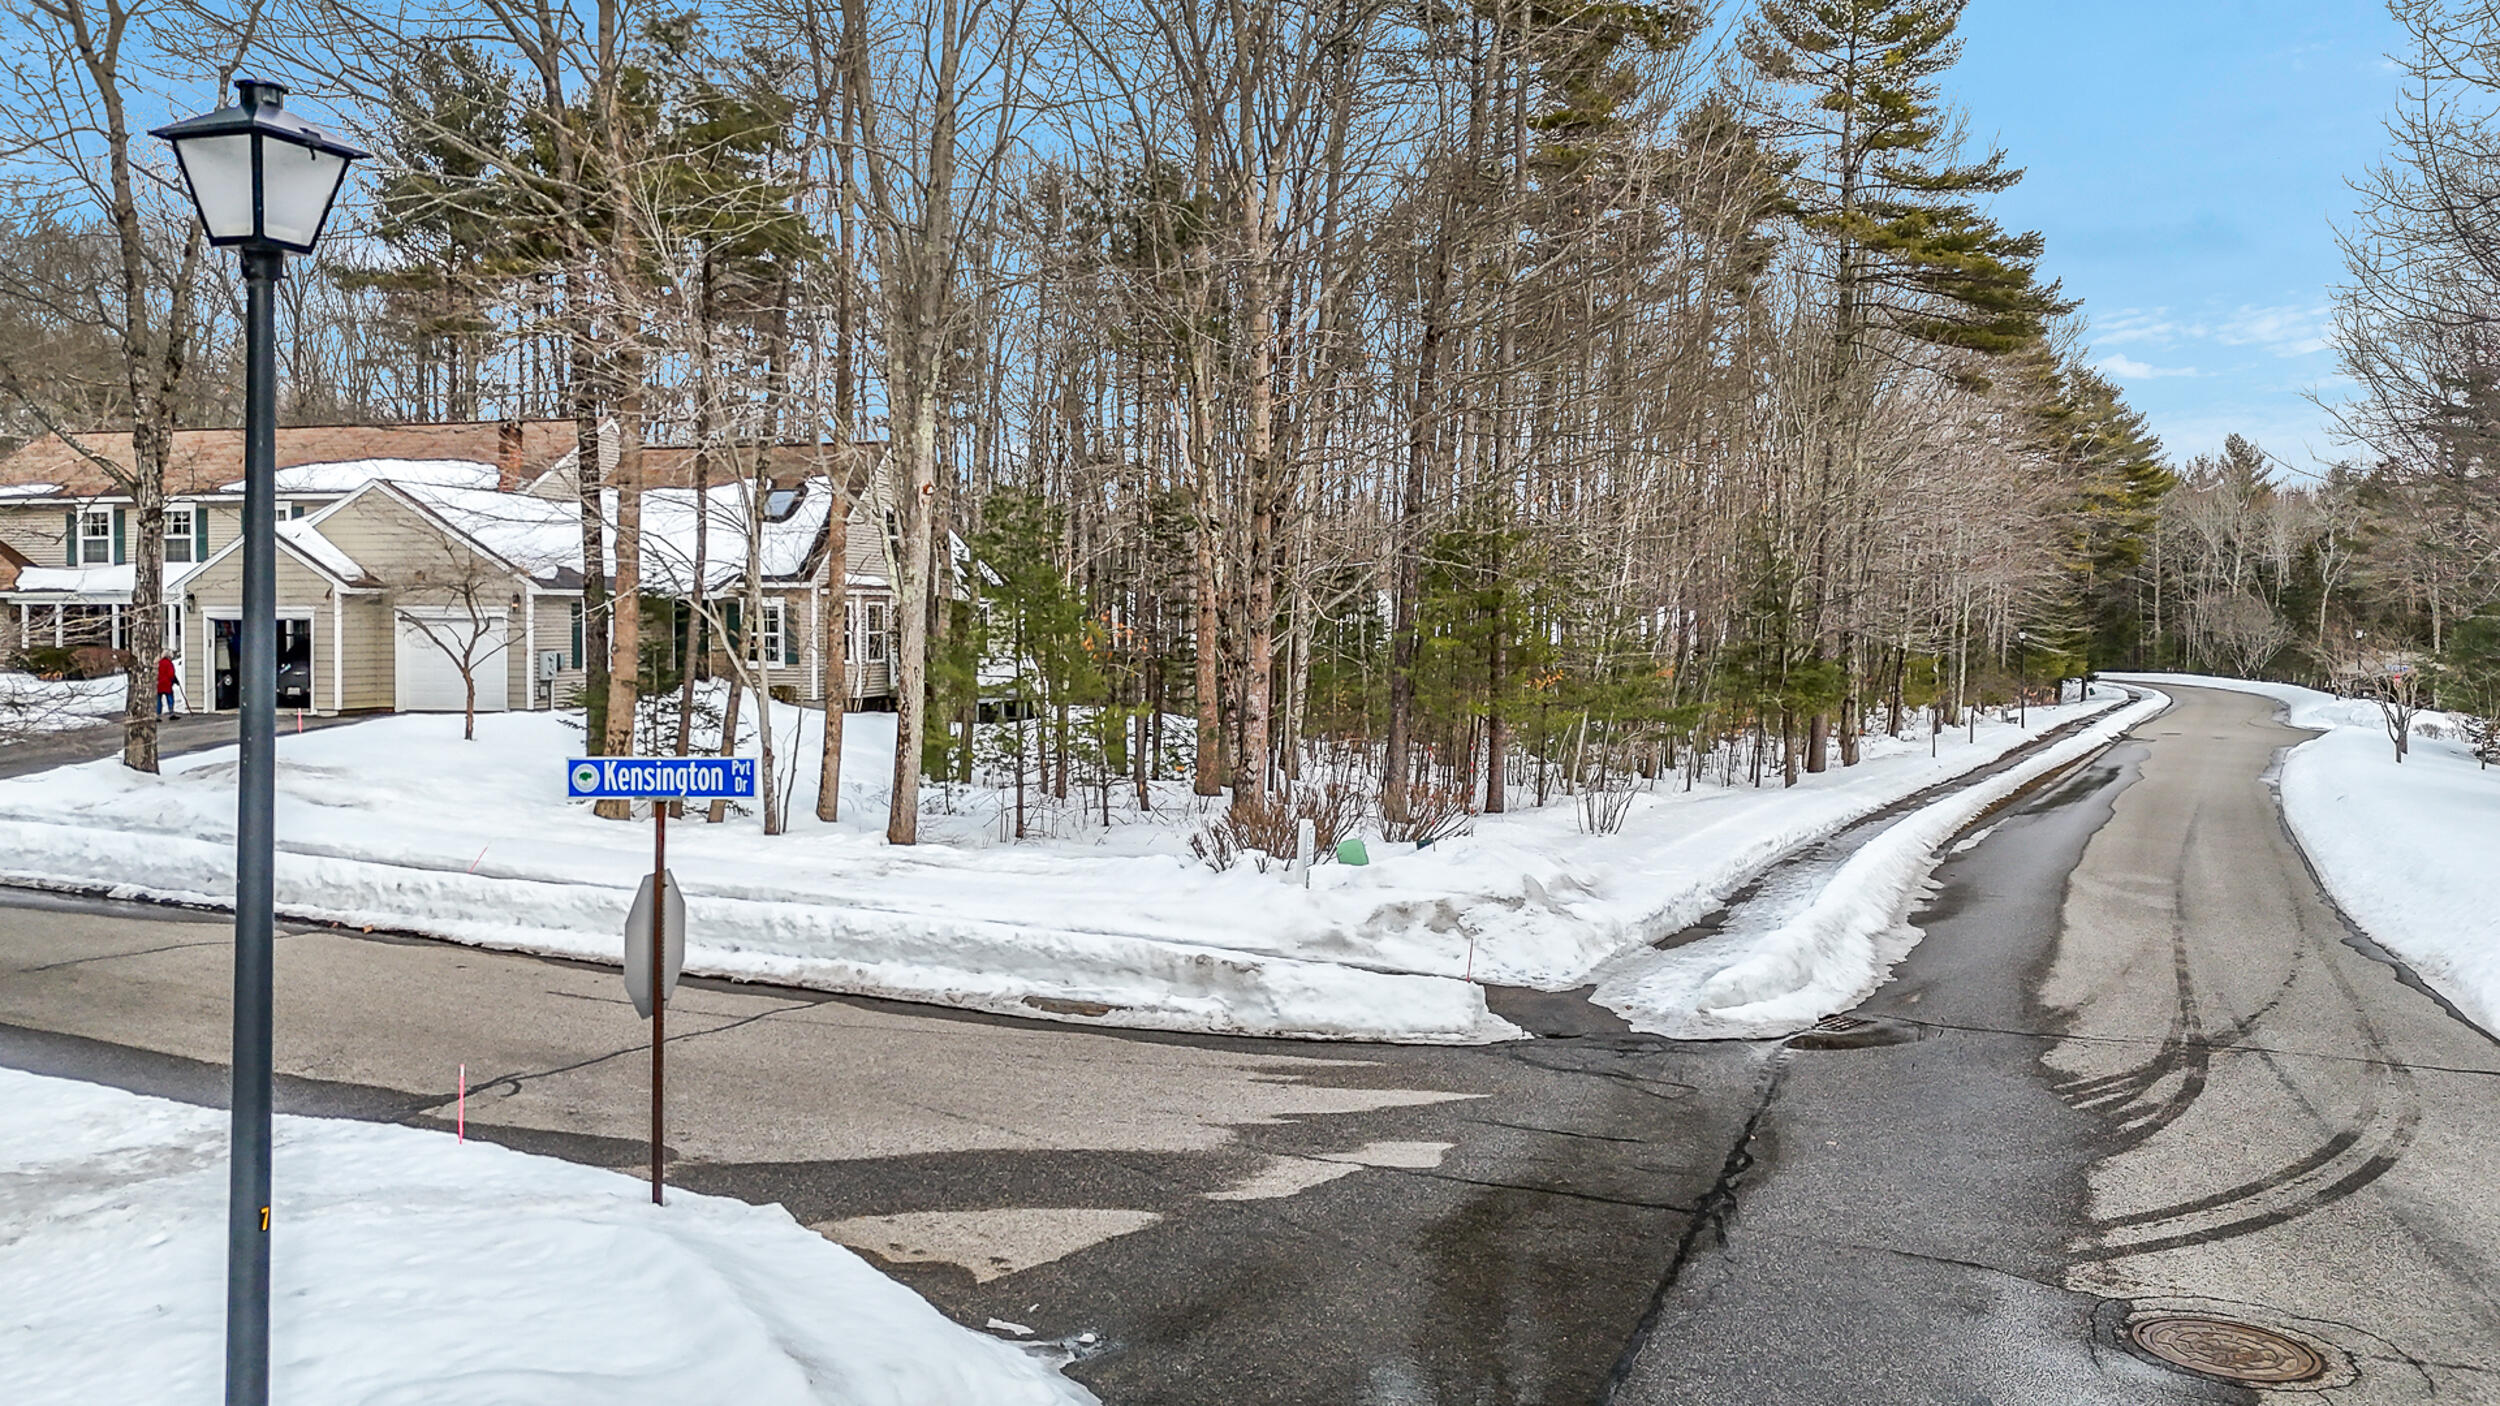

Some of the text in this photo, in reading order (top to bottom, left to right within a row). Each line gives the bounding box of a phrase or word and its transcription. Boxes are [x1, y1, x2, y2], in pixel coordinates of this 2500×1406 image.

[732, 760, 751, 776] Pvt
[604, 761, 723, 796] Kensington
[735, 776, 748, 792] Dr
[260, 1206, 270, 1231] 7
